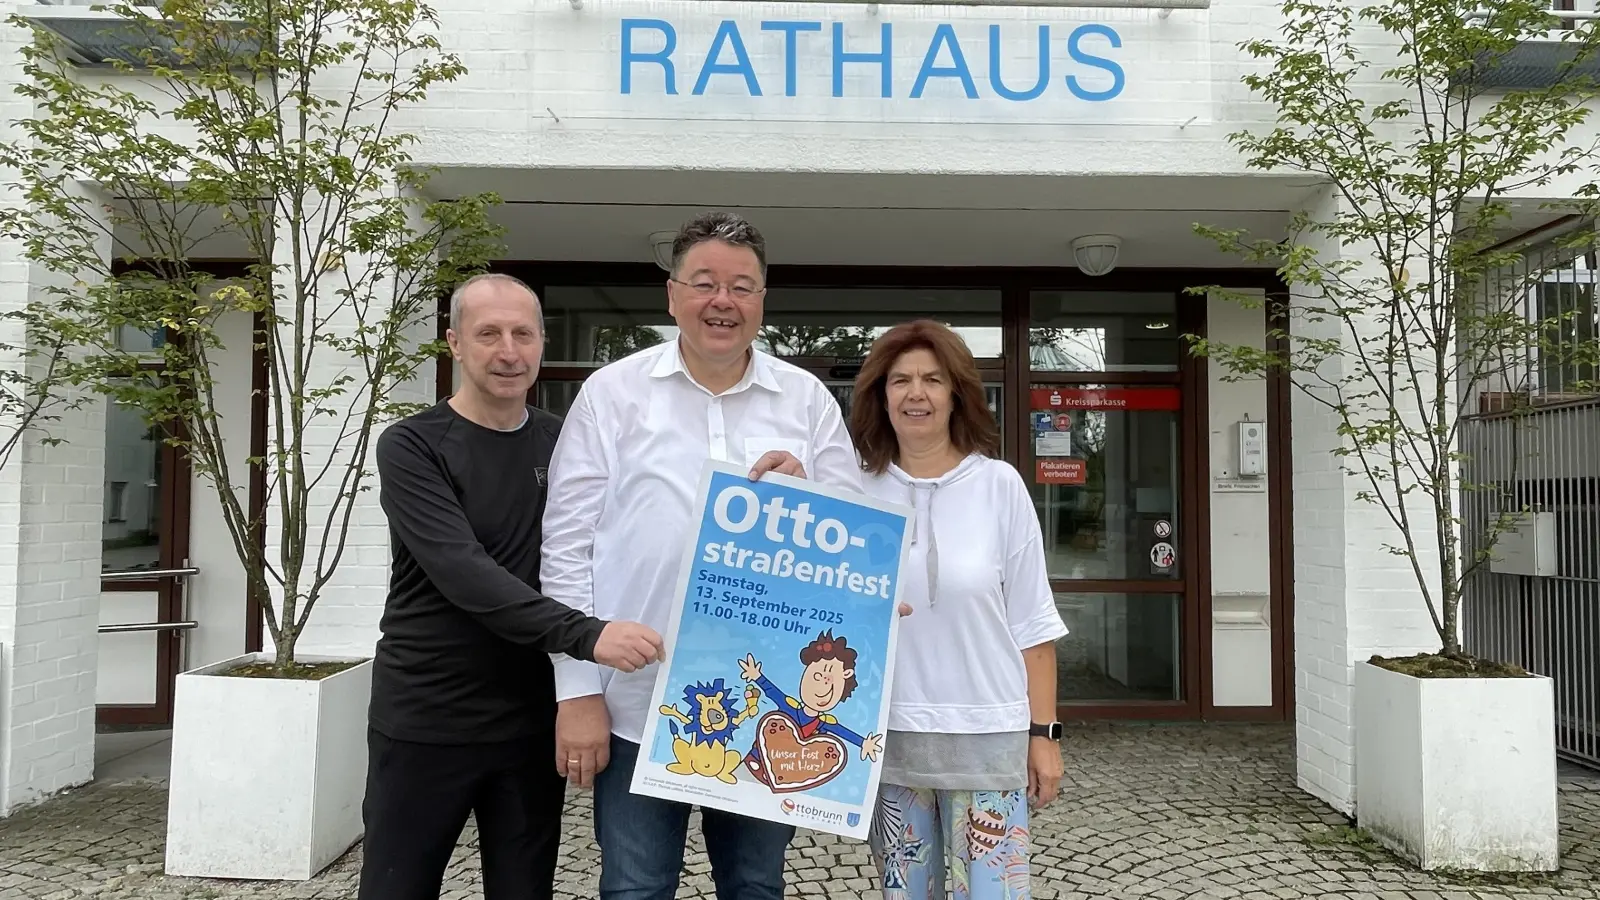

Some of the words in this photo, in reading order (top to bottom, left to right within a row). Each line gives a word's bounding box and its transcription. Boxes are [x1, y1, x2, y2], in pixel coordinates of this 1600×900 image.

[620, 18, 1126, 102] RATHAUS
[1065, 397, 1126, 408] Kreissparkasse
[1040, 461, 1081, 470] Plakatieren
[1043, 470, 1078, 478] verboten!
[712, 485, 867, 554] Otto-
[698, 569, 769, 596] Samstag,
[702, 541, 892, 600] straßenfest
[693, 601, 780, 629] 11.00-18.00
[784, 619, 811, 635] Uhr
[696, 585, 717, 600] 13.
[721, 590, 807, 617] September
[809, 608, 844, 625] 2025
[770, 749, 798, 760] Unser
[801, 747, 820, 760] Fest
[780, 761, 795, 771] mit
[798, 760, 825, 772] Herz!
